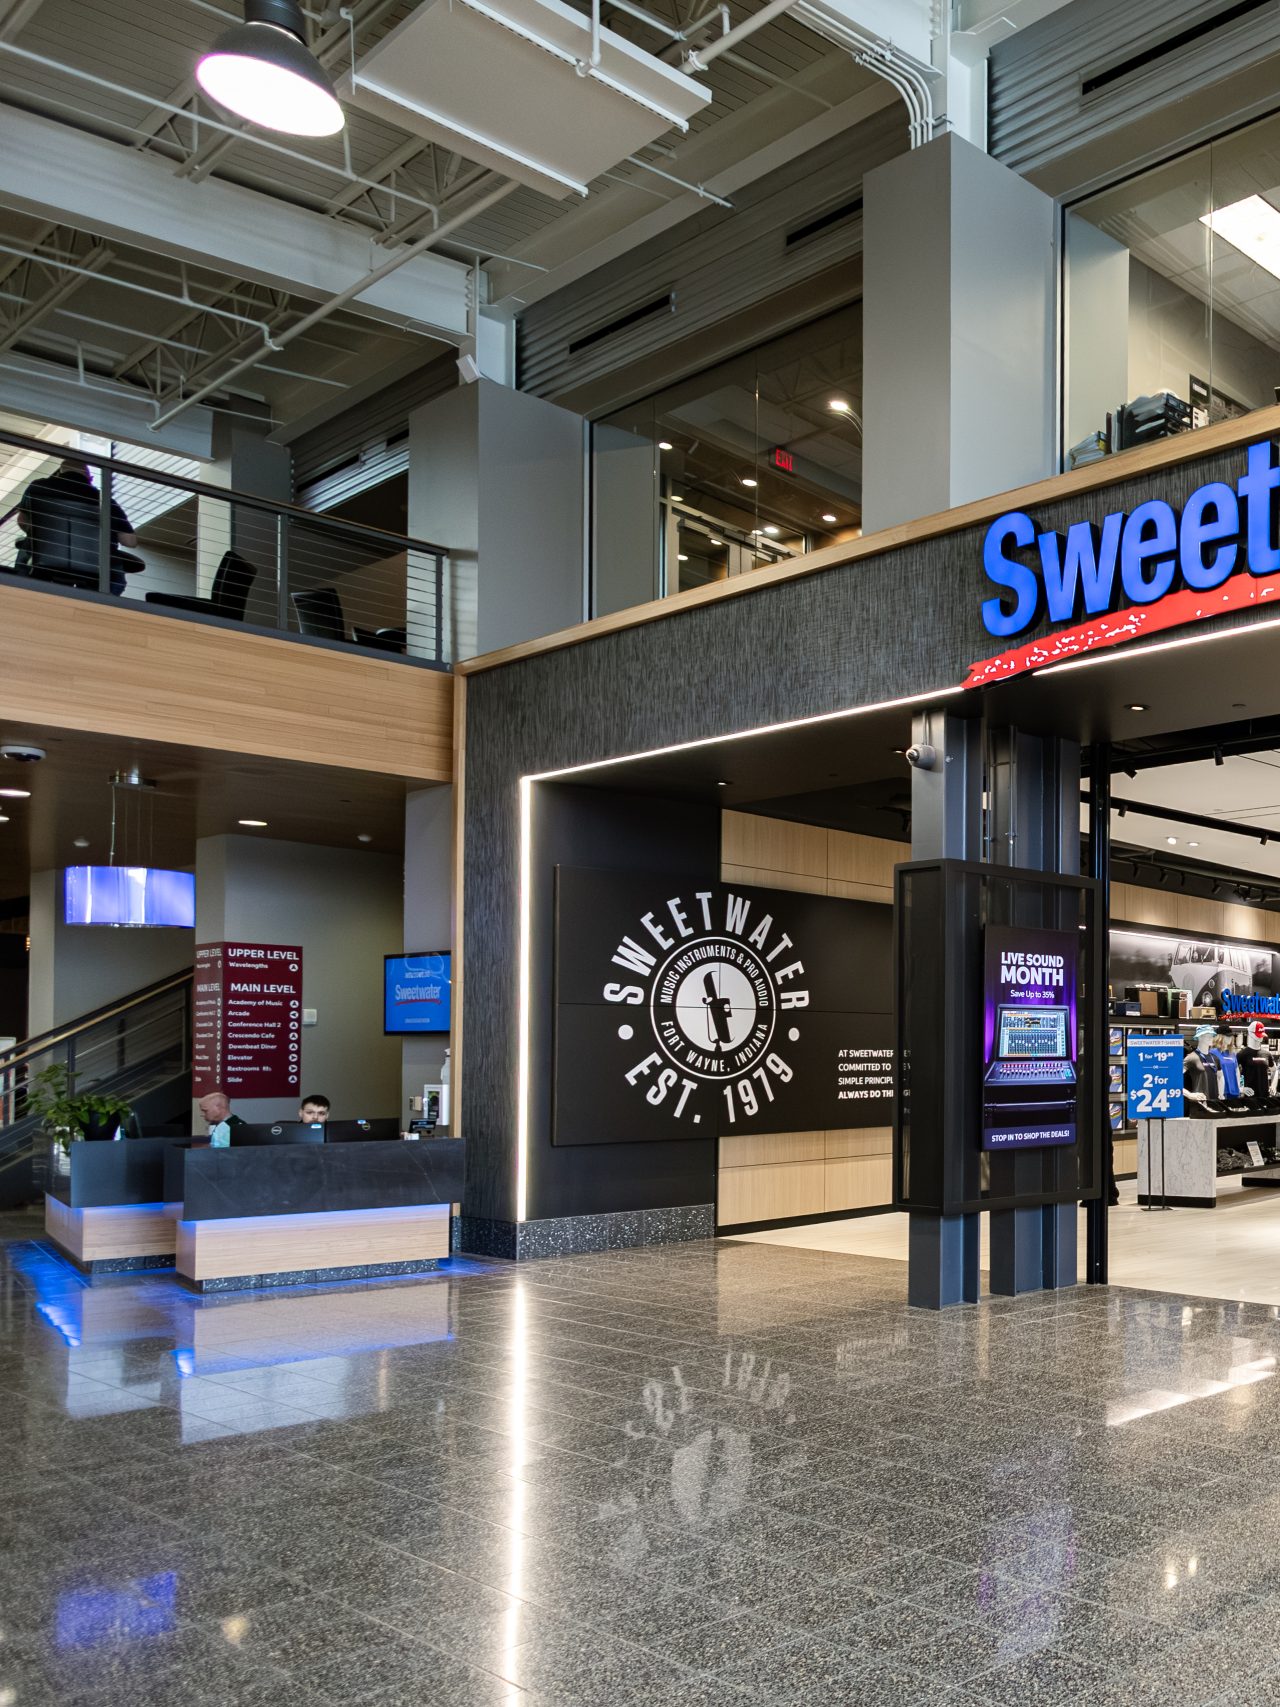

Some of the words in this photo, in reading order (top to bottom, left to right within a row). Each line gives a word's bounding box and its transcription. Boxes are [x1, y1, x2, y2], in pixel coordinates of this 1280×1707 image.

[775, 448, 793, 473] EXIT
[228, 949, 265, 958] UPPER
[267, 950, 299, 960] LEVEL
[603, 892, 810, 1010] SWEETWATER
[228, 961, 269, 969] Wavelengths
[1001, 951, 1025, 966] LIVE
[1026, 953, 1064, 967] SOUND
[660, 970, 680, 1004] MUSIC
[674, 945, 737, 971] INSTRUMENTS
[736, 952, 745, 964] &
[743, 957, 760, 979] PRO
[753, 976, 769, 1007] AUDIO
[1001, 965, 1064, 986] MONTH
[230, 983, 261, 992] MAIN
[263, 984, 296, 993] LEVEL
[395, 984, 442, 1000] Sweetwater
[1010, 990, 1024, 998] Save
[1026, 990, 1034, 999] Up
[1042, 991, 1055, 999] 35%
[661, 1021, 685, 1052] FORT
[734, 1023, 768, 1066] INDIANA
[838, 1050, 848, 1058] AT
[1138, 1052, 1144, 1062] 1
[838, 1063, 880, 1071] COMMITTED
[882, 1063, 891, 1071] TO
[838, 1077, 863, 1085] SIMPLE
[864, 1076, 893, 1085] PRINCIPL
[1143, 1074, 1154, 1088] 2
[1154, 1075, 1168, 1084] for
[624, 1051, 701, 1124] EST.
[723, 1052, 794, 1123] 1979
[838, 1090, 869, 1099] ALWAYS
[870, 1090, 881, 1098] DO
[1130, 1088, 1181, 1112] $24.99
[991, 1132, 1007, 1142] STOP
[1007, 1133, 1014, 1141] IN
[1014, 1132, 1023, 1140] TO
[1023, 1131, 1039, 1140] SHOP
[1040, 1131, 1050, 1139] THE
[1051, 1130, 1070, 1139] DEALS!
